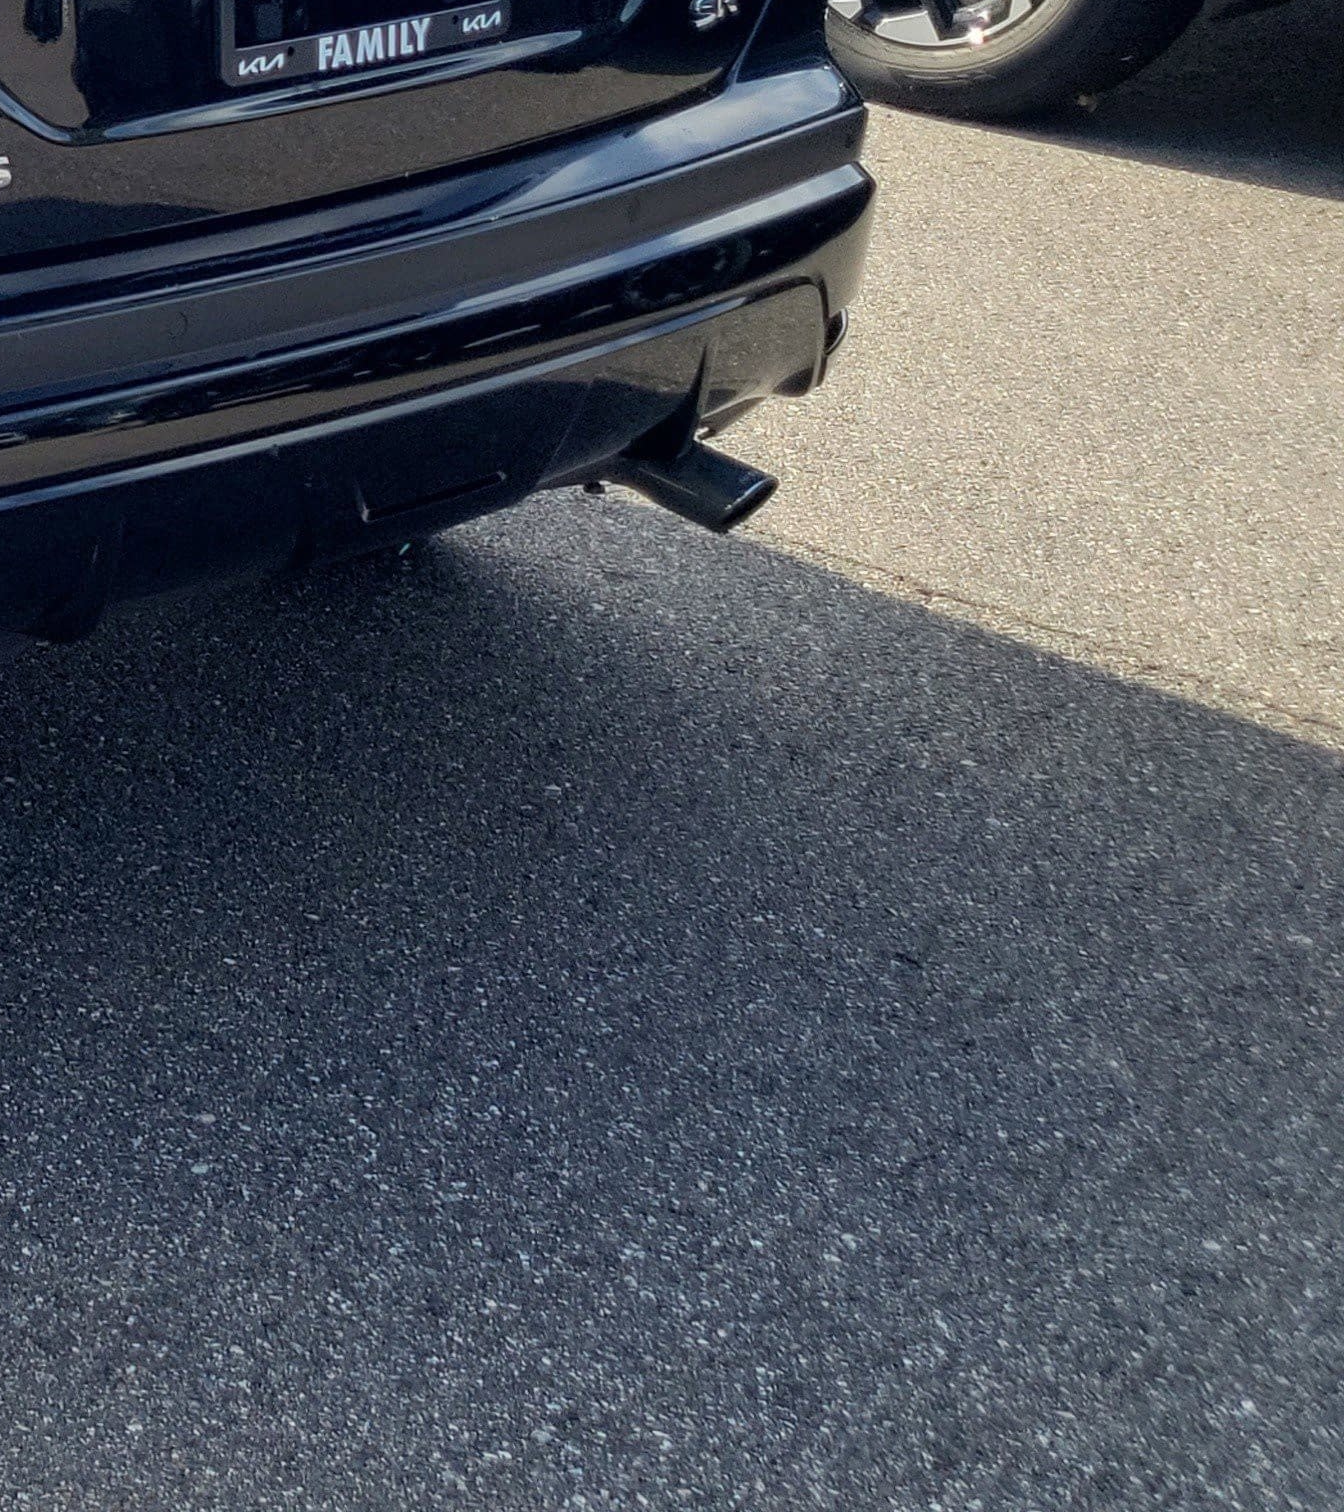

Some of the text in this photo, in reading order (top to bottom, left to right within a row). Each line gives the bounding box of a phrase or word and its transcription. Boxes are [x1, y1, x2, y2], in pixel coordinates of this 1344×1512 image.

[238, 10, 502, 76] KIA FAMILY KIA
